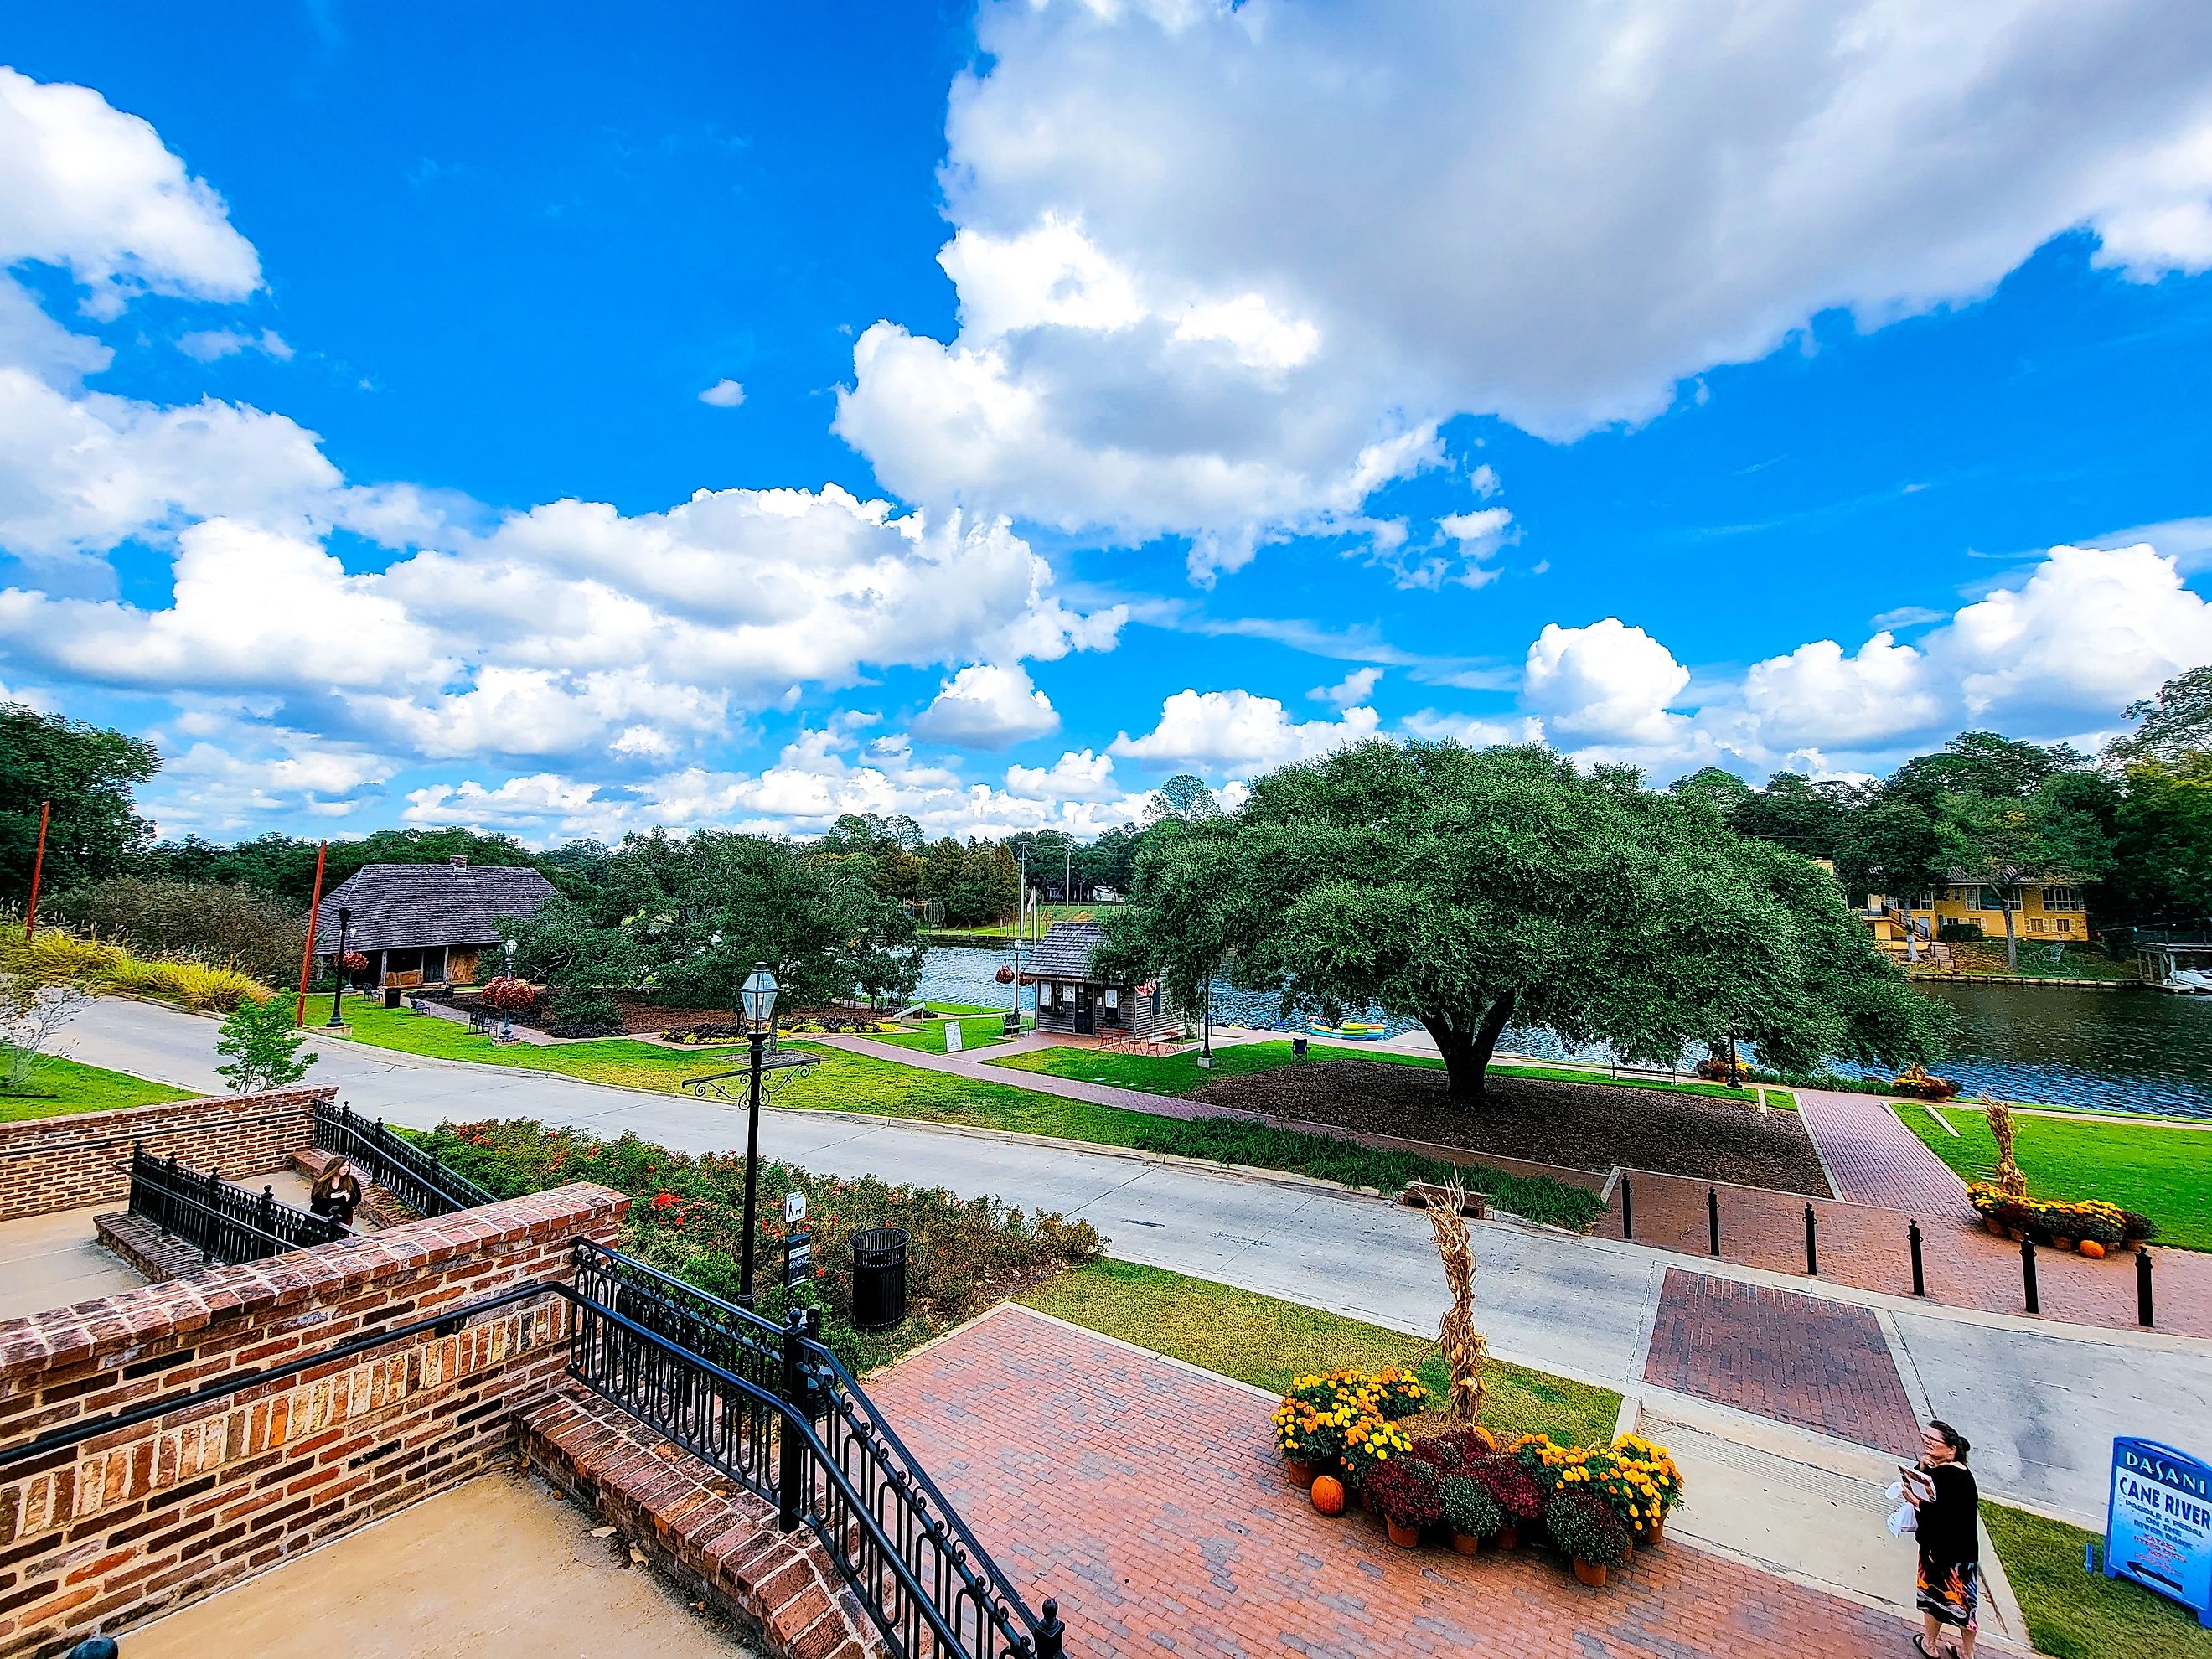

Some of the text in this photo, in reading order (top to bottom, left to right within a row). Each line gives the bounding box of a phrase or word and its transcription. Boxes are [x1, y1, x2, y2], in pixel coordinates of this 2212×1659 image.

[2126, 1451, 2205, 1494] DASANI
[2119, 1476, 2210, 1530] CANE RIVER
[2126, 1499, 2162, 1520] PADDLE
[2173, 1520, 2204, 1538] PEDAL
[2134, 1519, 2163, 1538] RIVER
[2146, 1517, 2182, 1537] ON THE
